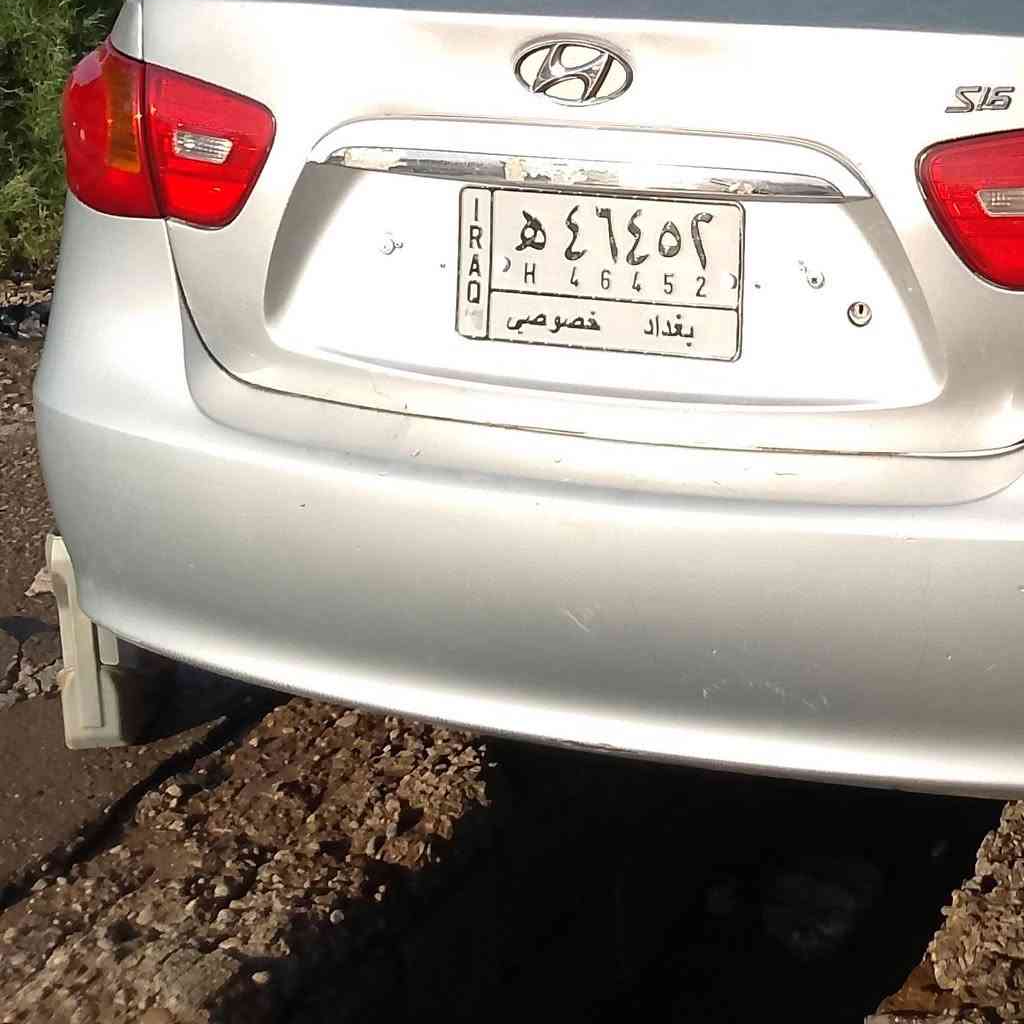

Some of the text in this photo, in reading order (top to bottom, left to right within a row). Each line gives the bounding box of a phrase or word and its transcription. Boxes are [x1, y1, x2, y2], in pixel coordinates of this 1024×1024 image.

[466, 197, 483, 305] IRAQ
[506, 311, 601, 335] خصوصي
[643, 312, 695, 347] بغداد
